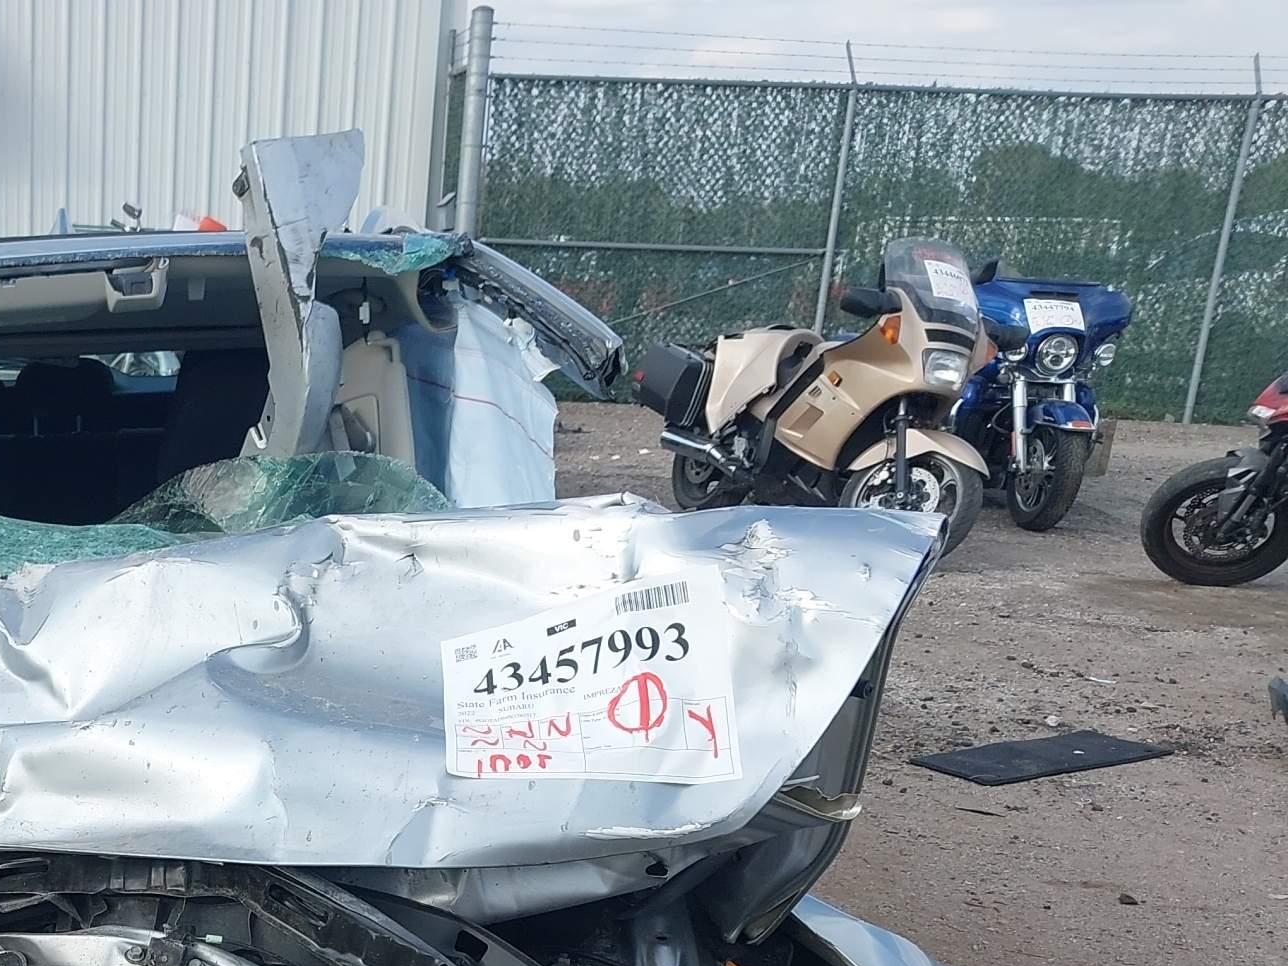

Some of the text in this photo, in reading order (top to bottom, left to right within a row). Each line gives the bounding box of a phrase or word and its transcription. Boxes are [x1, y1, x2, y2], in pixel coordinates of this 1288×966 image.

[474, 622, 690, 695] 43457993
[457, 686, 576, 709] State Farm Insurance
[583, 686, 622, 700] IMPREZA
